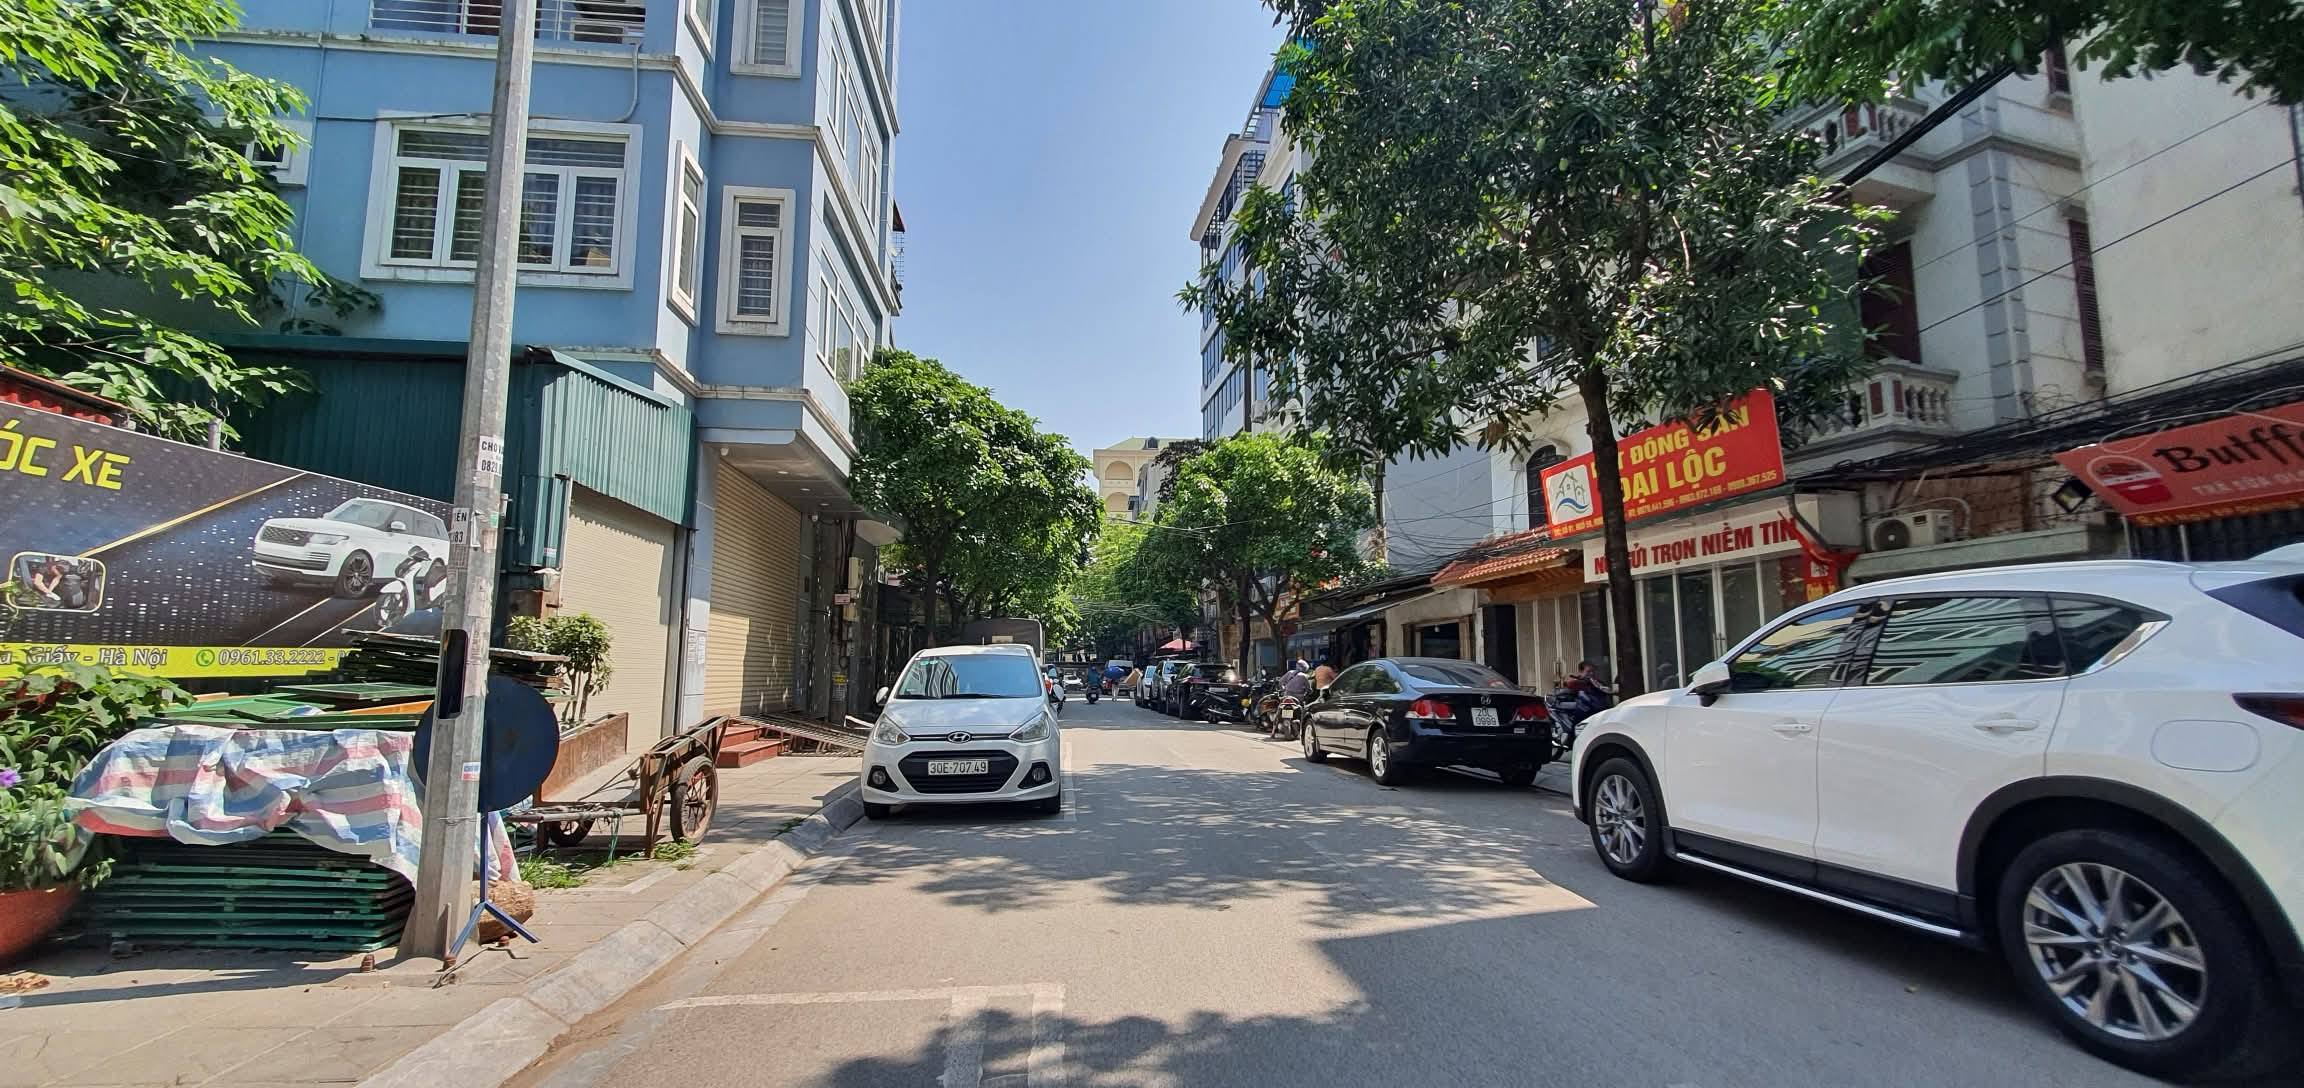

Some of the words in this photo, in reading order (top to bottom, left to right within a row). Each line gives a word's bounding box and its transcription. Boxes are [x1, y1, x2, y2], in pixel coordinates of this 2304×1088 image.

[1630, 428, 1690, 464] ĐỘNG
[61, 445, 131, 490] XE
[1665, 447, 1727, 489] LỘC
[1651, 537, 1697, 566] TRỌN
[1701, 522, 1754, 557] NIỀM
[1759, 517, 1797, 546] TIN
[100, 648, 127, 666] Hà
[132, 647, 168, 669] Nội
[218, 649, 325, 666] 0961.33.2222
[930, 761, 987, 774] 30E-707.49
